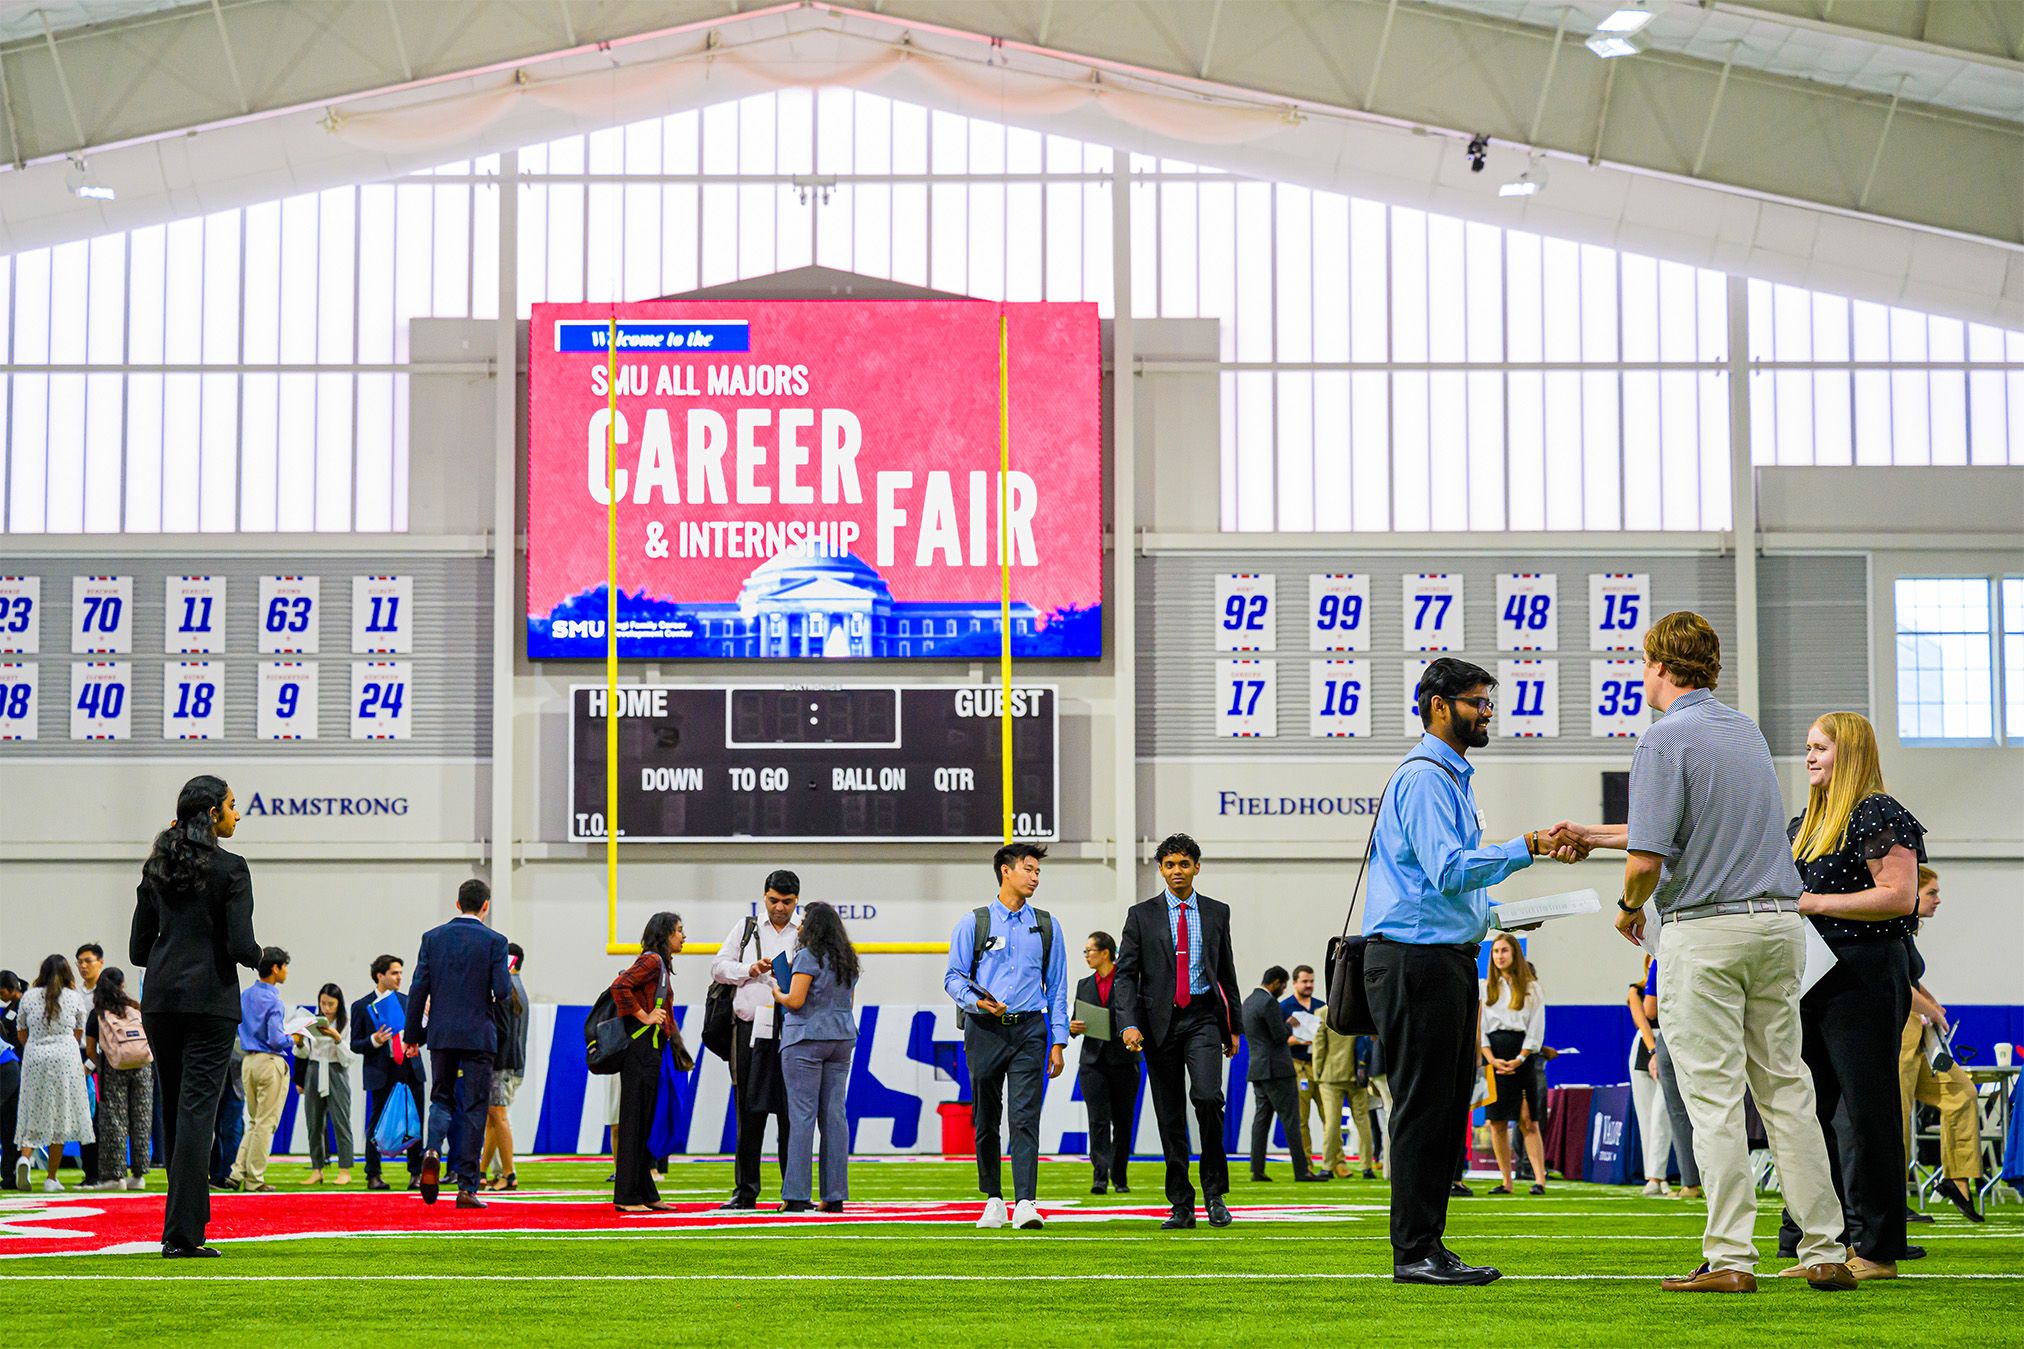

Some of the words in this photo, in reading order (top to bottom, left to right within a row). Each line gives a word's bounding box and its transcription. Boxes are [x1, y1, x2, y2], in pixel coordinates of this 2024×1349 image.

[592, 330, 664, 347] Wlcome
[667, 332, 684, 347] to
[687, 330, 714, 347] the
[591, 365, 648, 396] SMU
[655, 365, 701, 396] ALL
[707, 365, 809, 396] MAJORS
[588, 408, 863, 505] CAREER
[876, 471, 1039, 567] FAIR
[645, 521, 669, 558] &
[679, 521, 860, 559] INTERNSHIP
[82, 597, 122, 632] 70
[179, 597, 212, 632] 11
[266, 597, 312, 632] 63
[365, 597, 399, 632] 11
[552, 620, 605, 638] SMU
[1223, 595, 1268, 630] 92
[1317, 595, 1362, 630] 99
[1414, 595, 1453, 630] 77
[1503, 595, 1550, 630] 48
[1600, 595, 1641, 630] 15
[77, 683, 125, 718] 40
[173, 683, 215, 718] 18
[276, 683, 299, 718] 9
[359, 683, 404, 718] 24
[589, 690, 668, 717] HOME
[954, 690, 1044, 717] GUEST
[1227, 681, 1265, 716] 17
[1320, 681, 1361, 716] 16
[1512, 681, 1544, 716] 11
[1598, 681, 1644, 716] 35
[642, 768, 703, 791] DOWN
[729, 768, 756, 791] TO
[760, 768, 789, 791] GO
[832, 768, 877, 791] BALL
[879, 768, 906, 791] ON
[934, 768, 974, 792] QTR
[576, 813, 625, 836] T.O..
[1010, 813, 1050, 836] .O.L.
